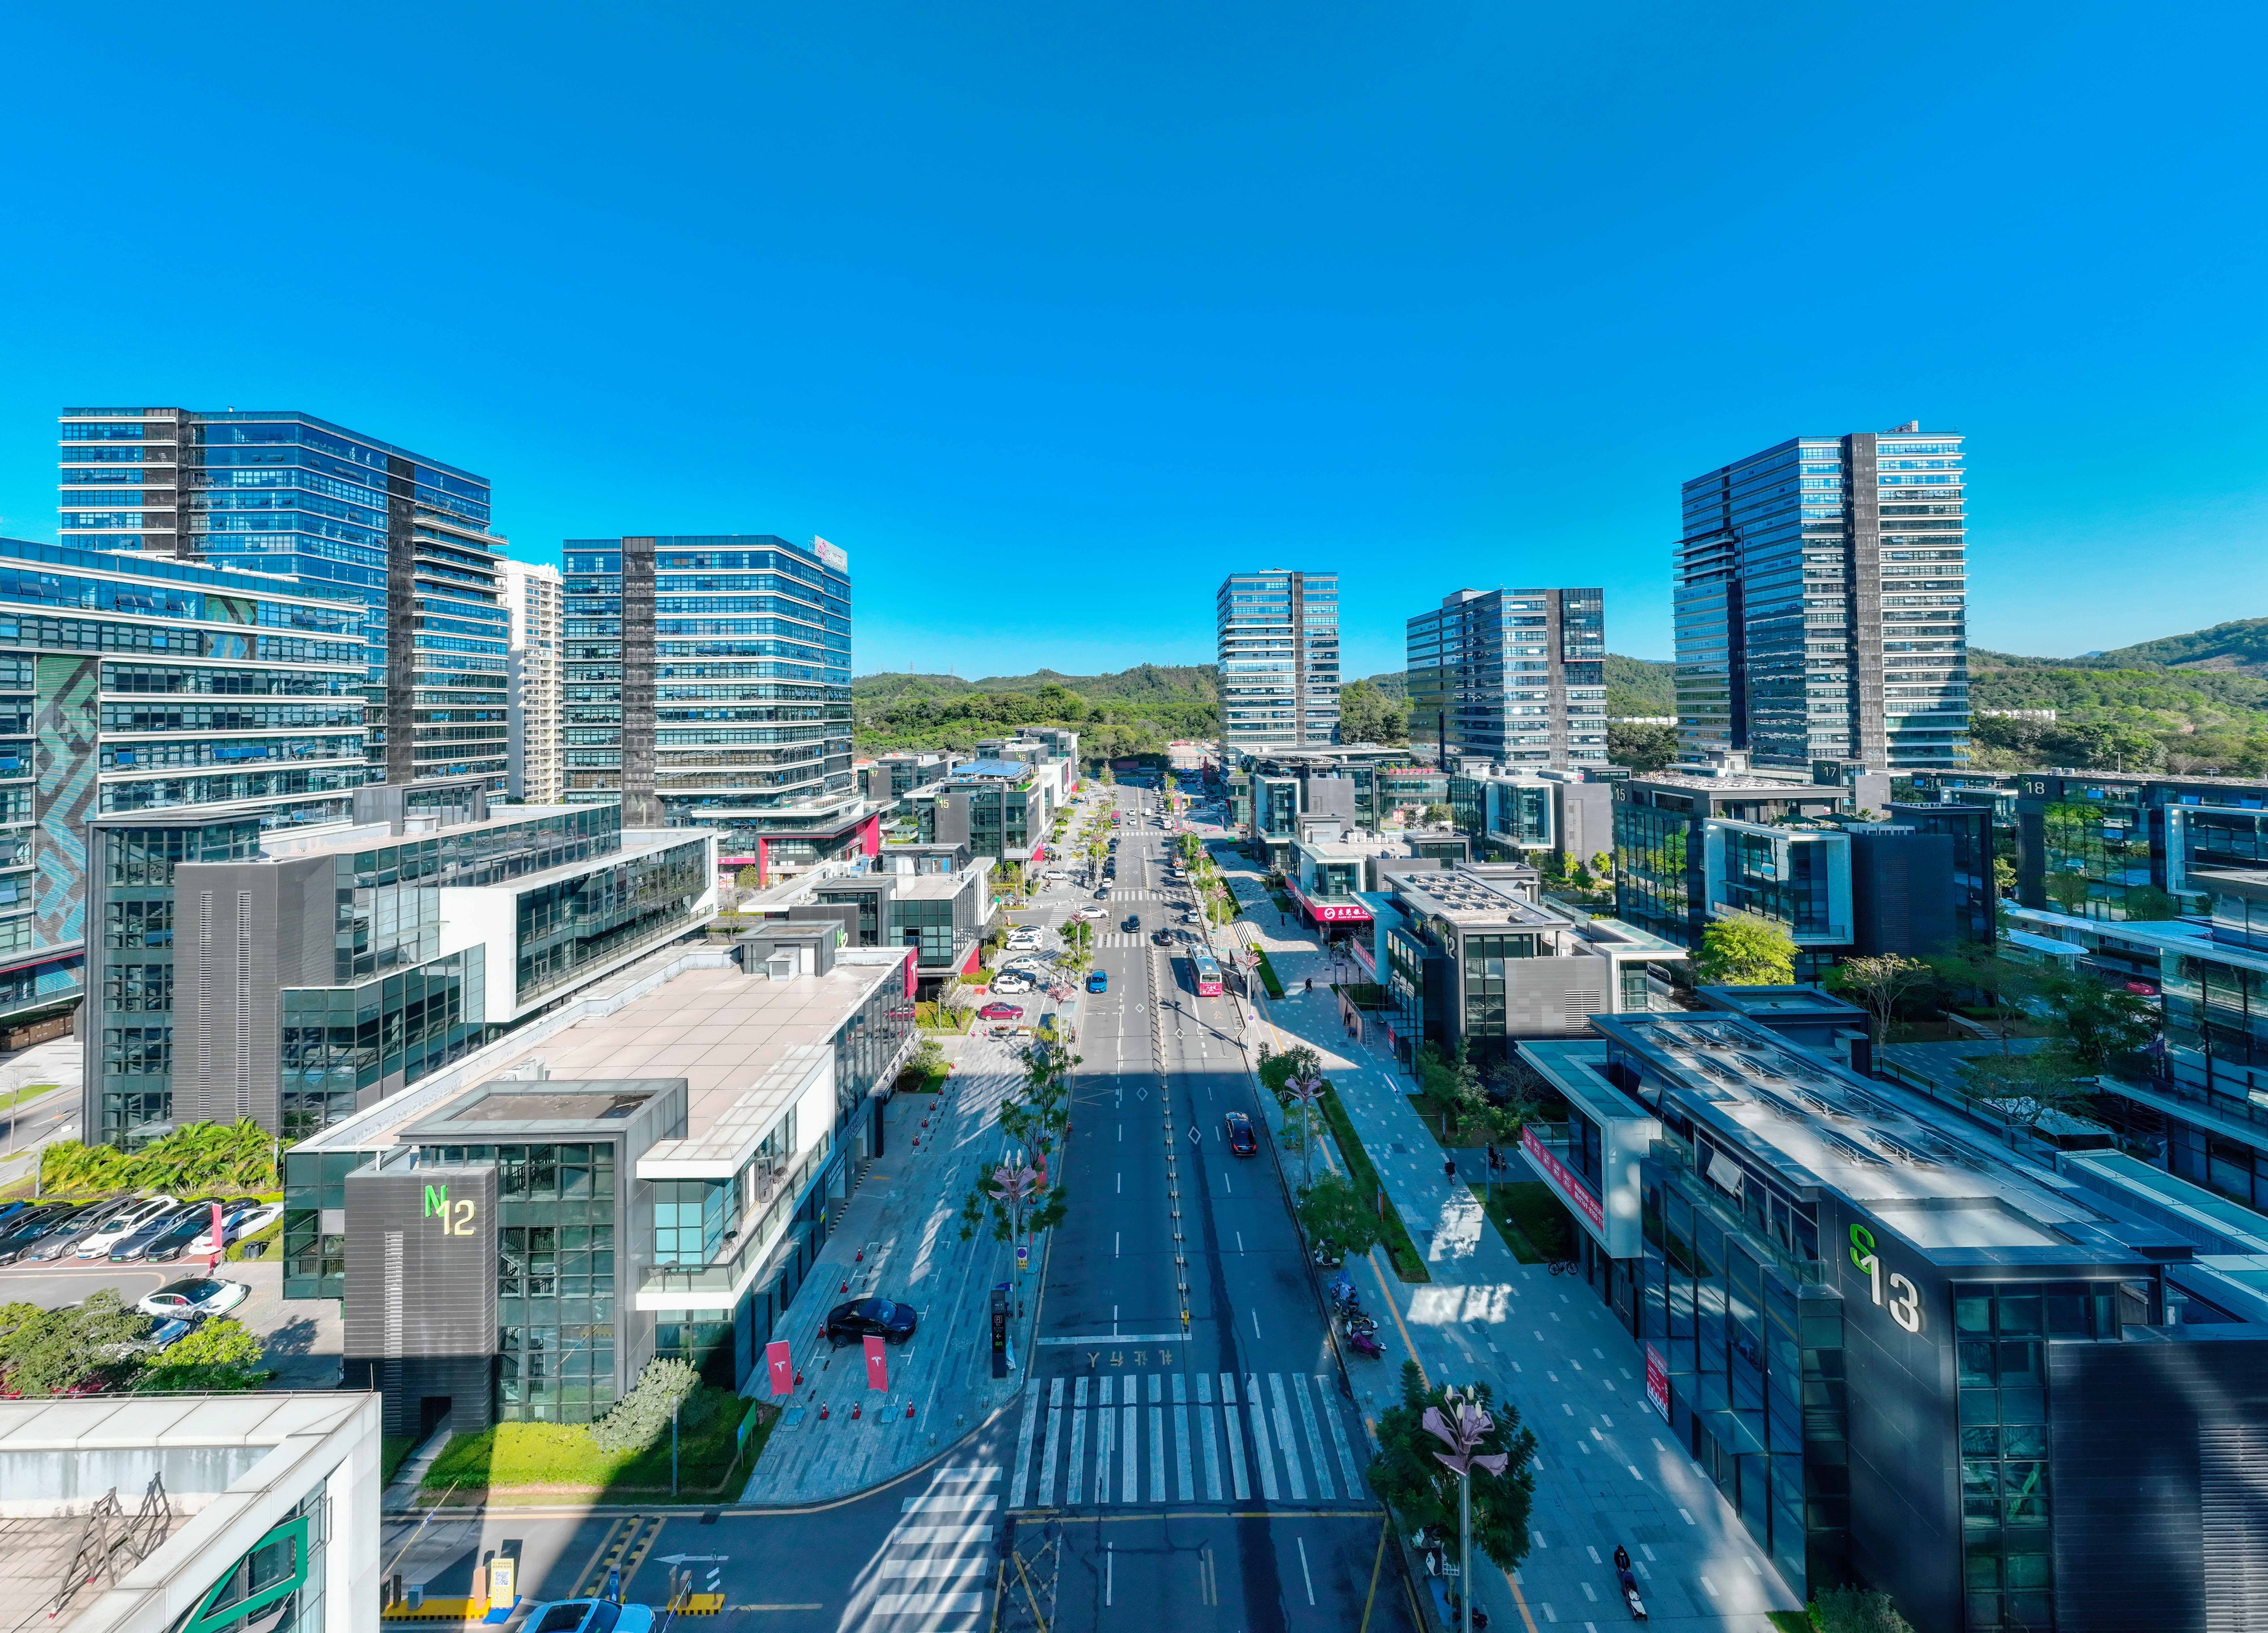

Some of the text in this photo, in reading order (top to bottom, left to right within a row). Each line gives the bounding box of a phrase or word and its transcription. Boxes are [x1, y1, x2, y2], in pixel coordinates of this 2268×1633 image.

[1016, 752, 1026, 762] N16
[1553, 751, 1565, 759] S2
[869, 768, 878, 777] N17
[1822, 763, 1837, 777] S17
[1613, 783, 1626, 801] S15
[2022, 776, 2045, 794] S18
[936, 796, 949, 809] N15
[425, 1185, 475, 1235] N12
[1850, 1223, 1919, 1332] S13
[1087, 1349, 1173, 1368] 礼让行人
